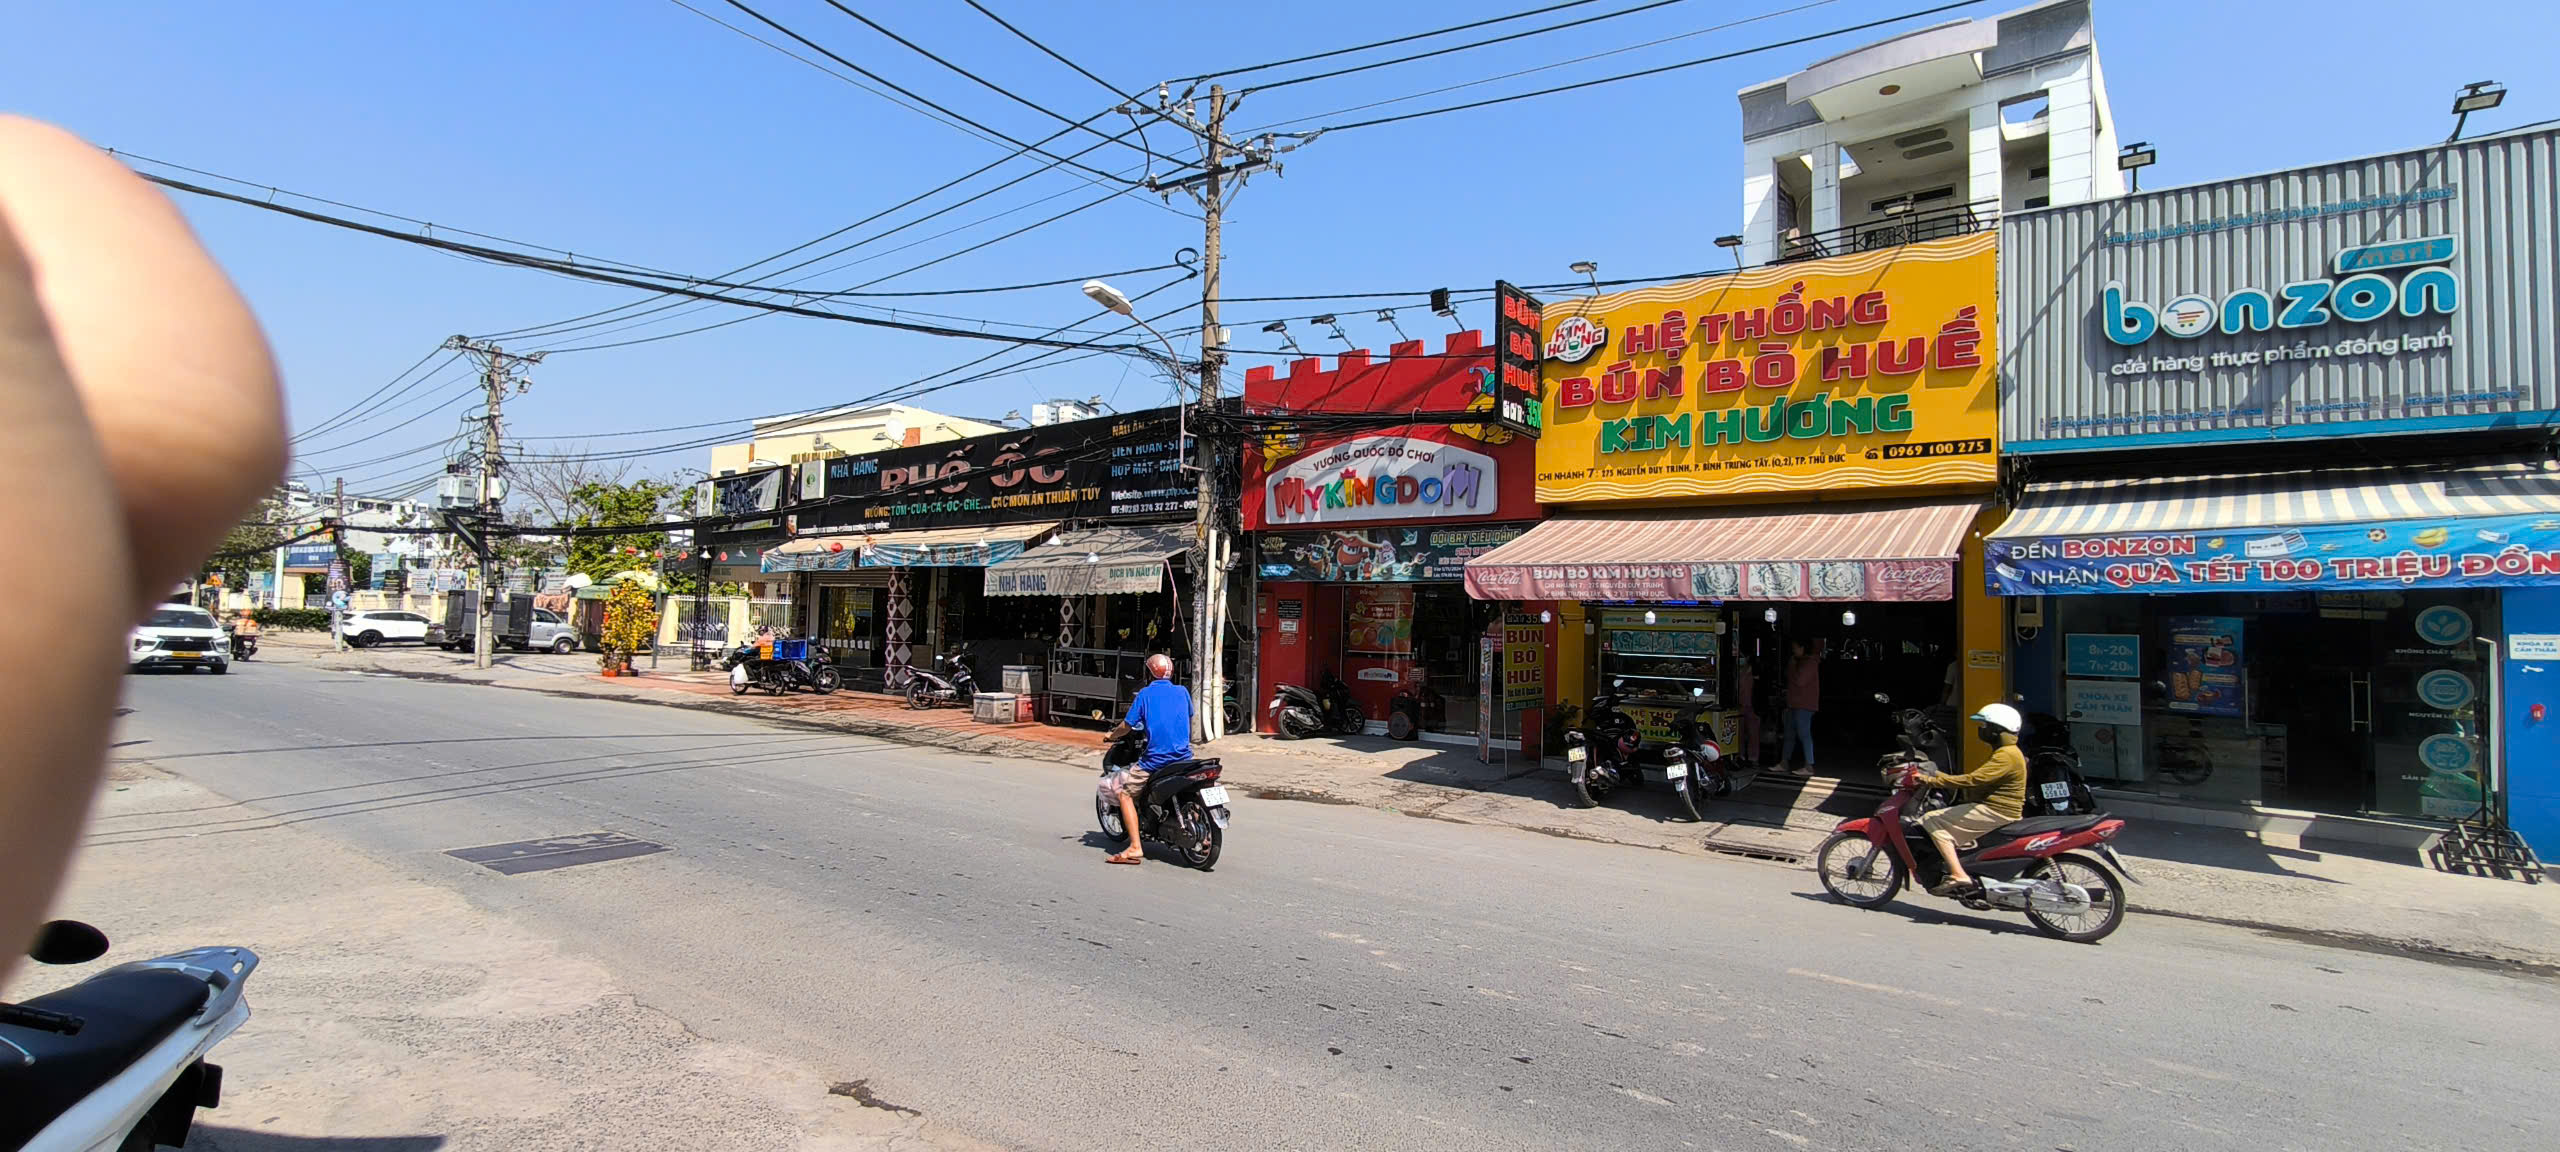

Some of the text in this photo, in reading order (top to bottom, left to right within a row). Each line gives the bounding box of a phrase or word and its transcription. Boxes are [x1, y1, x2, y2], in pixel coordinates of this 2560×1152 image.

[2355, 242, 2434, 266] mart
[1504, 295, 1541, 333] BÚN
[2102, 266, 2460, 345] bonzon
[1625, 280, 1889, 358] HỆ THỐNG
[1555, 322, 1587, 343] KIM
[1510, 331, 1533, 361] BÒ
[1559, 305, 1982, 409] BÚN BÒ HUẾ
[2111, 330, 2453, 375] cửa hàng thực phẩm đông lạnh
[1524, 398, 1542, 428] 35K
[1600, 394, 1914, 454] KIM HƯƠNG
[1313, 445, 1435, 471] VƯƠNG QUỐC ĐỒ CHƠI
[1889, 440, 1985, 457] 0969 100 275
[831, 457, 878, 478] NHÀ HÀNG
[880, 435, 1068, 495] PHỐ ỐC
[1538, 472, 1552, 481] CHI
[1554, 470, 1584, 480] NHÁNH
[1602, 467, 1614, 477] 275
[1616, 464, 1646, 477] NGUYỄN
[1649, 465, 1663, 475] DUY
[1694, 463, 1701, 472] P.
[1703, 460, 1722, 471] BÌNH
[1724, 459, 1752, 470] TRƯNG
[1795, 456, 1807, 466] TP.
[1808, 452, 1826, 464] THỦ
[1828, 453, 1846, 464] ĐỨC
[1045, 482, 1078, 504] THUẦN
[1080, 482, 1101, 500] TÚY
[1155, 502, 1164, 511] 37
[1165, 501, 1178, 510] 277
[1448, 531, 1469, 545] BAY
[1470, 529, 1492, 544] SIÊU
[2011, 536, 2196, 559] ĐẾN BONZON
[1477, 570, 1522, 585] Coca-Cola
[1533, 565, 1685, 579] BÚN BÒ KIM HƯƠNG
[1877, 565, 1948, 584] Coca-Cola
[2031, 561, 2098, 587] NHẬN
[2104, 558, 2180, 588] QUÀ
[2185, 554, 2250, 582] TẾT
[2258, 558, 2322, 582] 100
[2328, 550, 2451, 583] TRIỆU
[998, 572, 1016, 592] NHÀ
[1505, 627, 1544, 644] BÚN
[1513, 647, 1537, 664] BÒ
[1507, 665, 1541, 684] HUẾ
